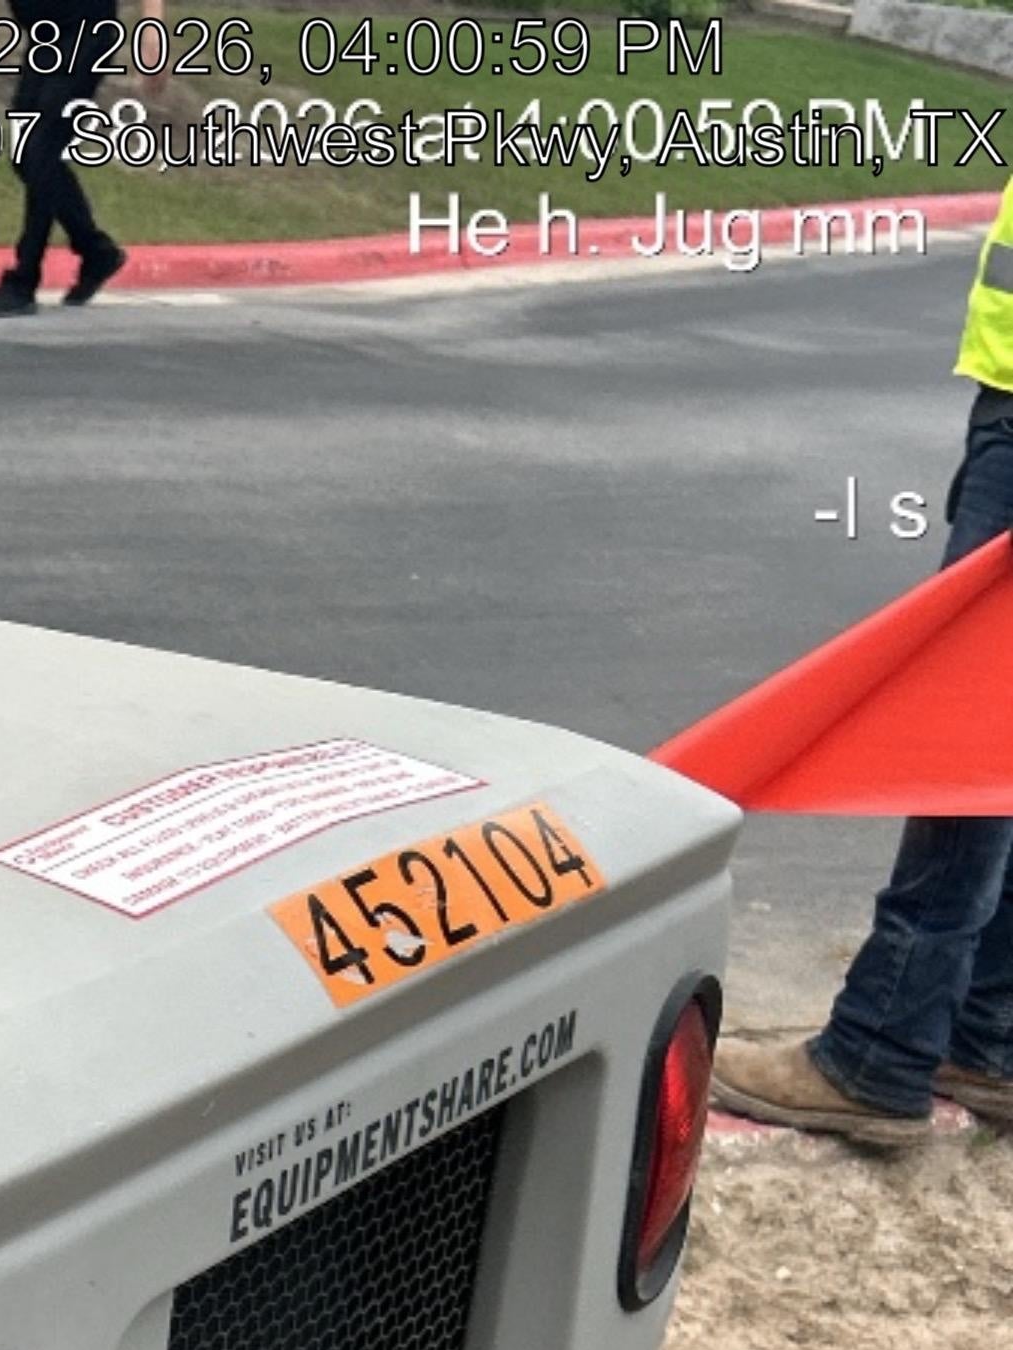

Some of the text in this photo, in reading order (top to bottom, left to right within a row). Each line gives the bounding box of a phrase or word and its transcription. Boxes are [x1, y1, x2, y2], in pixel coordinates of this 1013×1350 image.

[307, 809, 594, 985] 452104
[229, 1008, 578, 1243] EQUIPMENTSHARE.COM
[235, 1101, 352, 1177] VISIT US AT:
